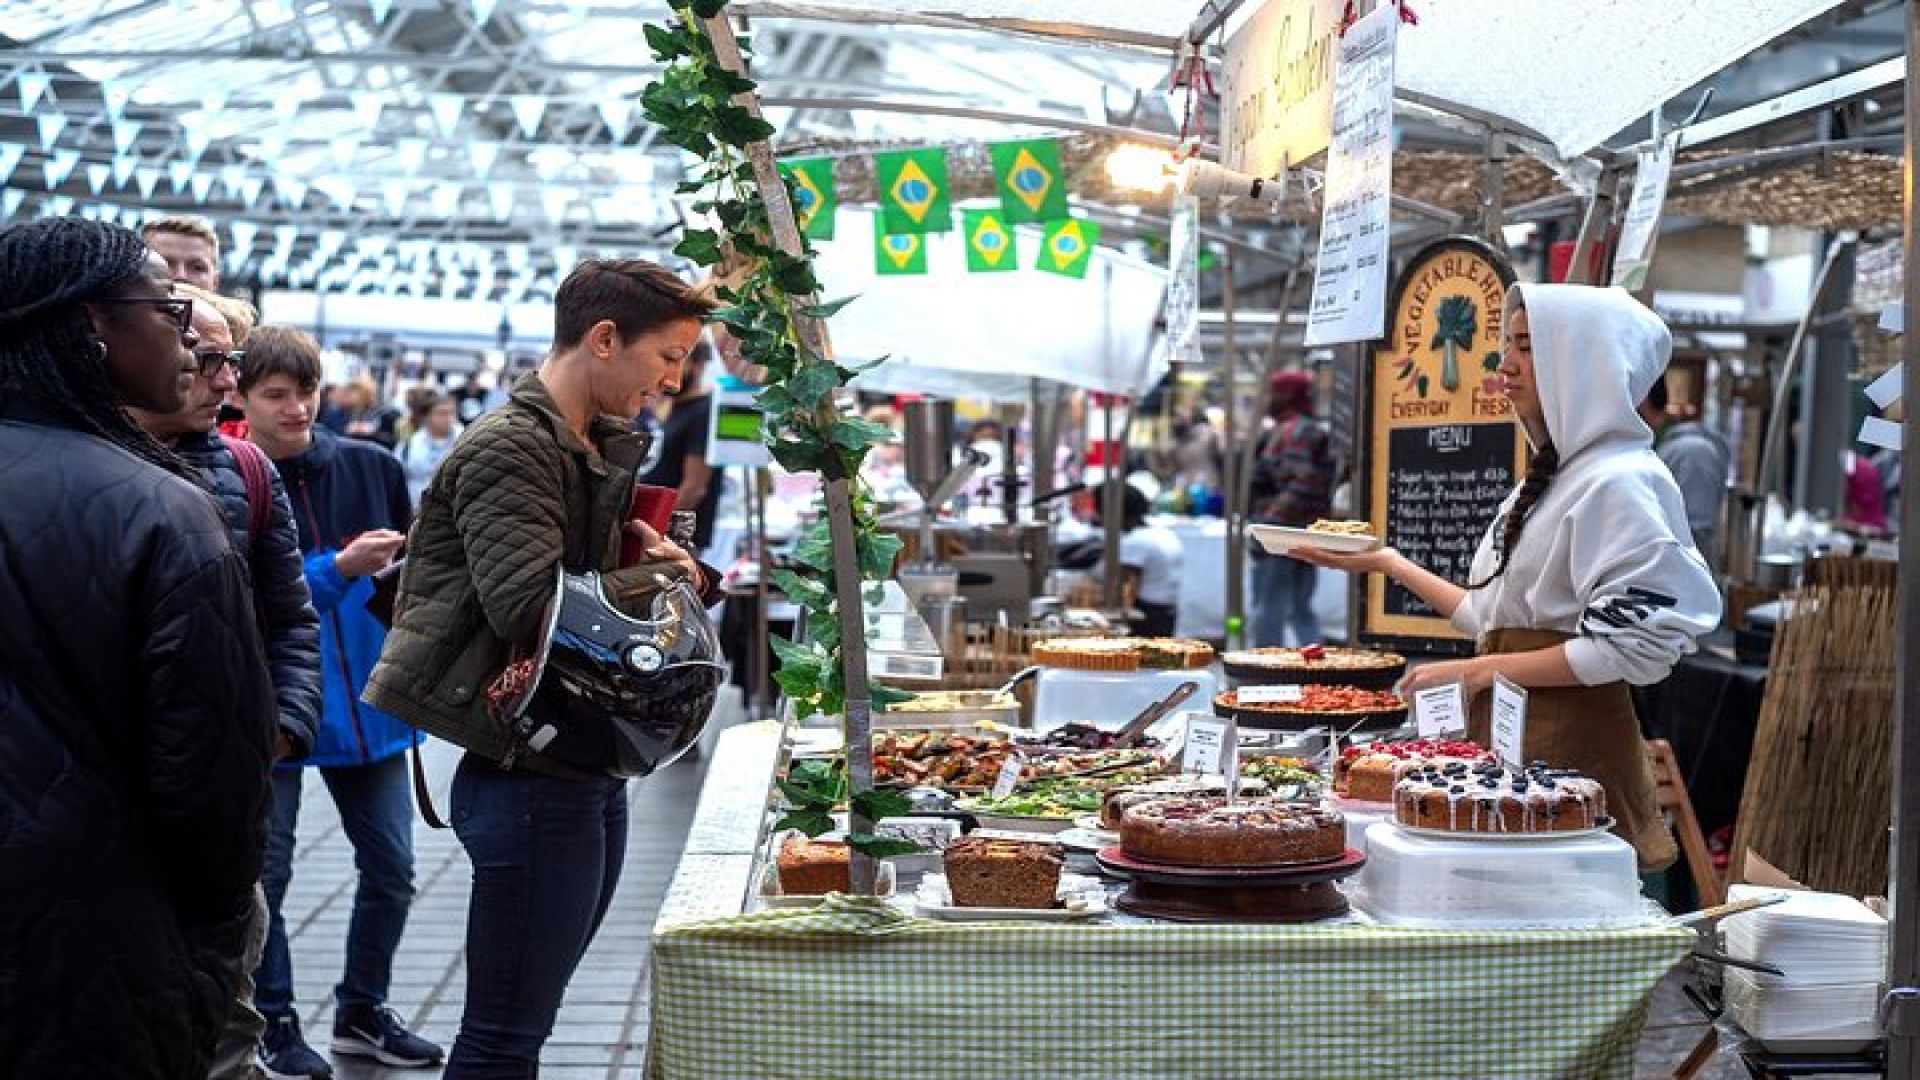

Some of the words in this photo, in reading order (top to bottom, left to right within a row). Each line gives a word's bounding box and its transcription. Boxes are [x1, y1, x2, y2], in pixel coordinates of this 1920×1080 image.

[1404, 255, 1483, 354] VEGETABLE
[1479, 270, 1502, 341] HERE
[1391, 392, 1450, 419] EVERYDAY
[1428, 426, 1473, 447] MENU
